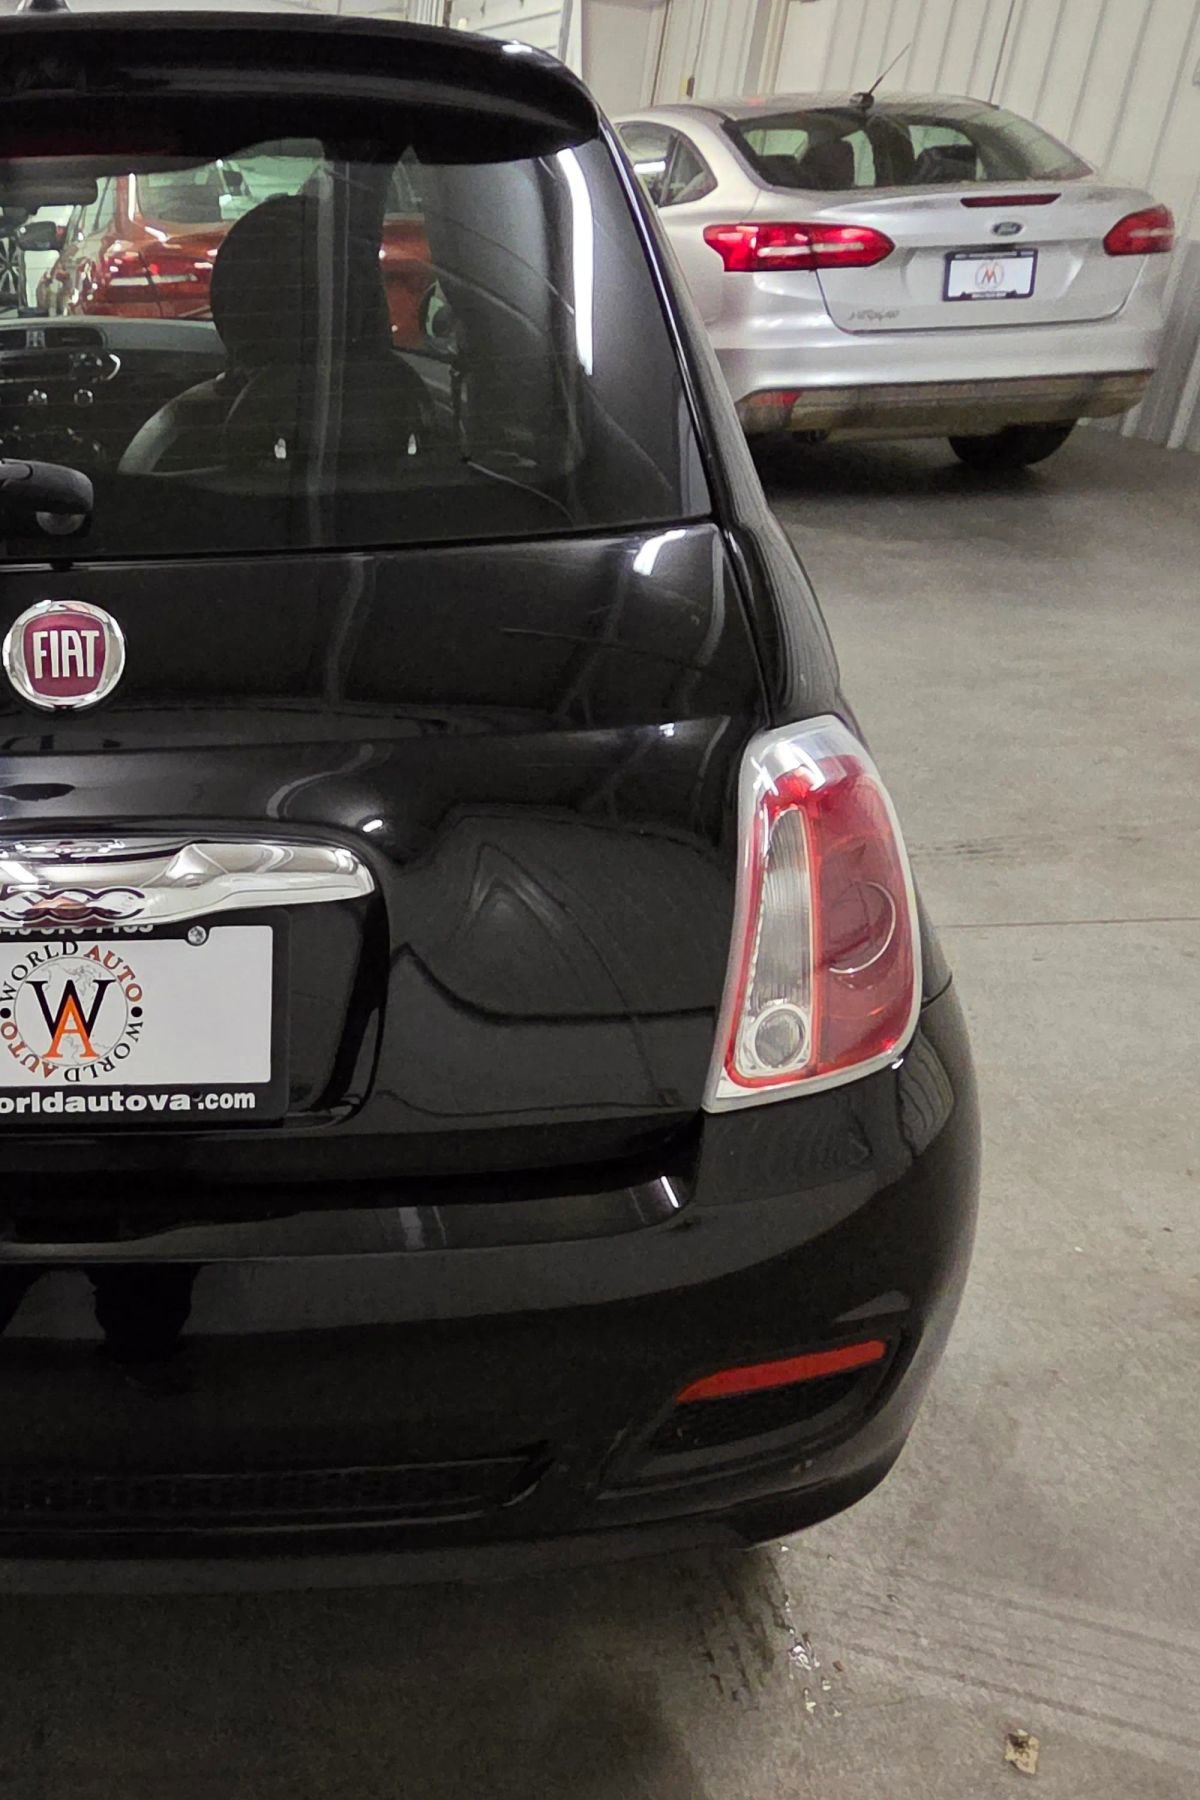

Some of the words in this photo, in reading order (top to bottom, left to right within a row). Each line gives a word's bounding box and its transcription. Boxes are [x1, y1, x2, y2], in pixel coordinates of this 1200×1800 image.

[32, 630, 100, 679] FIAT
[0, 940, 79, 1002] WORLD
[83, 945, 143, 1002] AUTO
[0, 1021, 59, 1079] AUTO
[64, 1021, 143, 1083] WORLD
